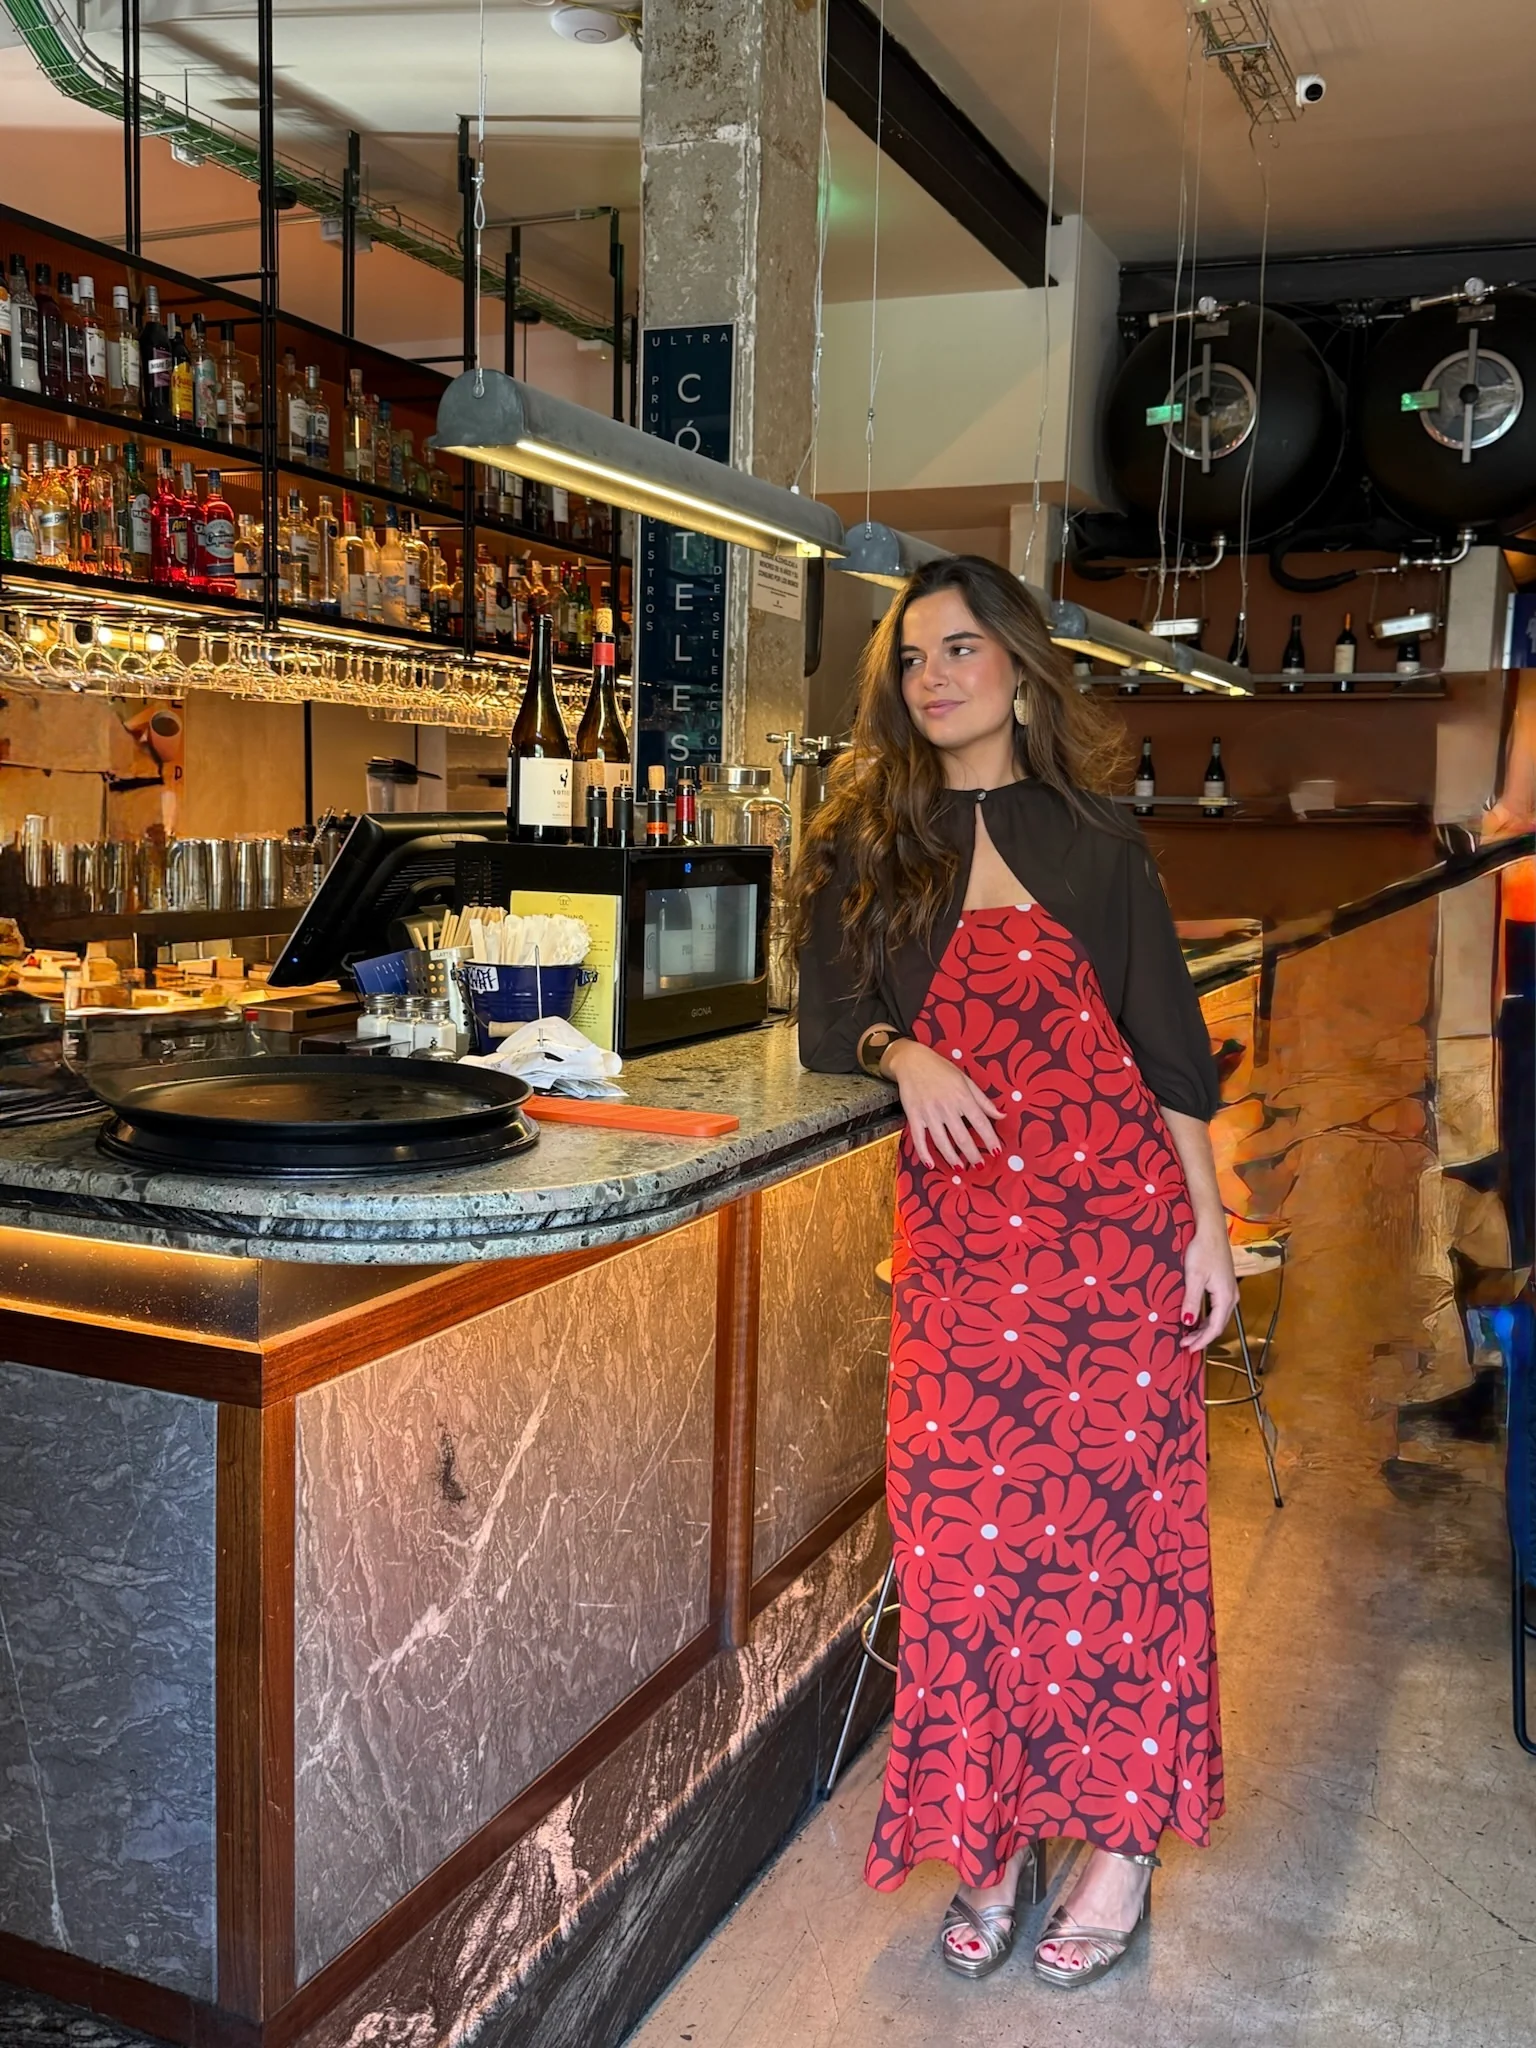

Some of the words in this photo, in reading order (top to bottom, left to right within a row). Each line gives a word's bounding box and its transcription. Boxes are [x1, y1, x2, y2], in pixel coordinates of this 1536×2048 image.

[651, 332, 729, 347] ULTRA
[670, 373, 701, 762] CÓTELES
[713, 565, 723, 594] DE
[708, 612, 721, 762] SELECCIÓN
